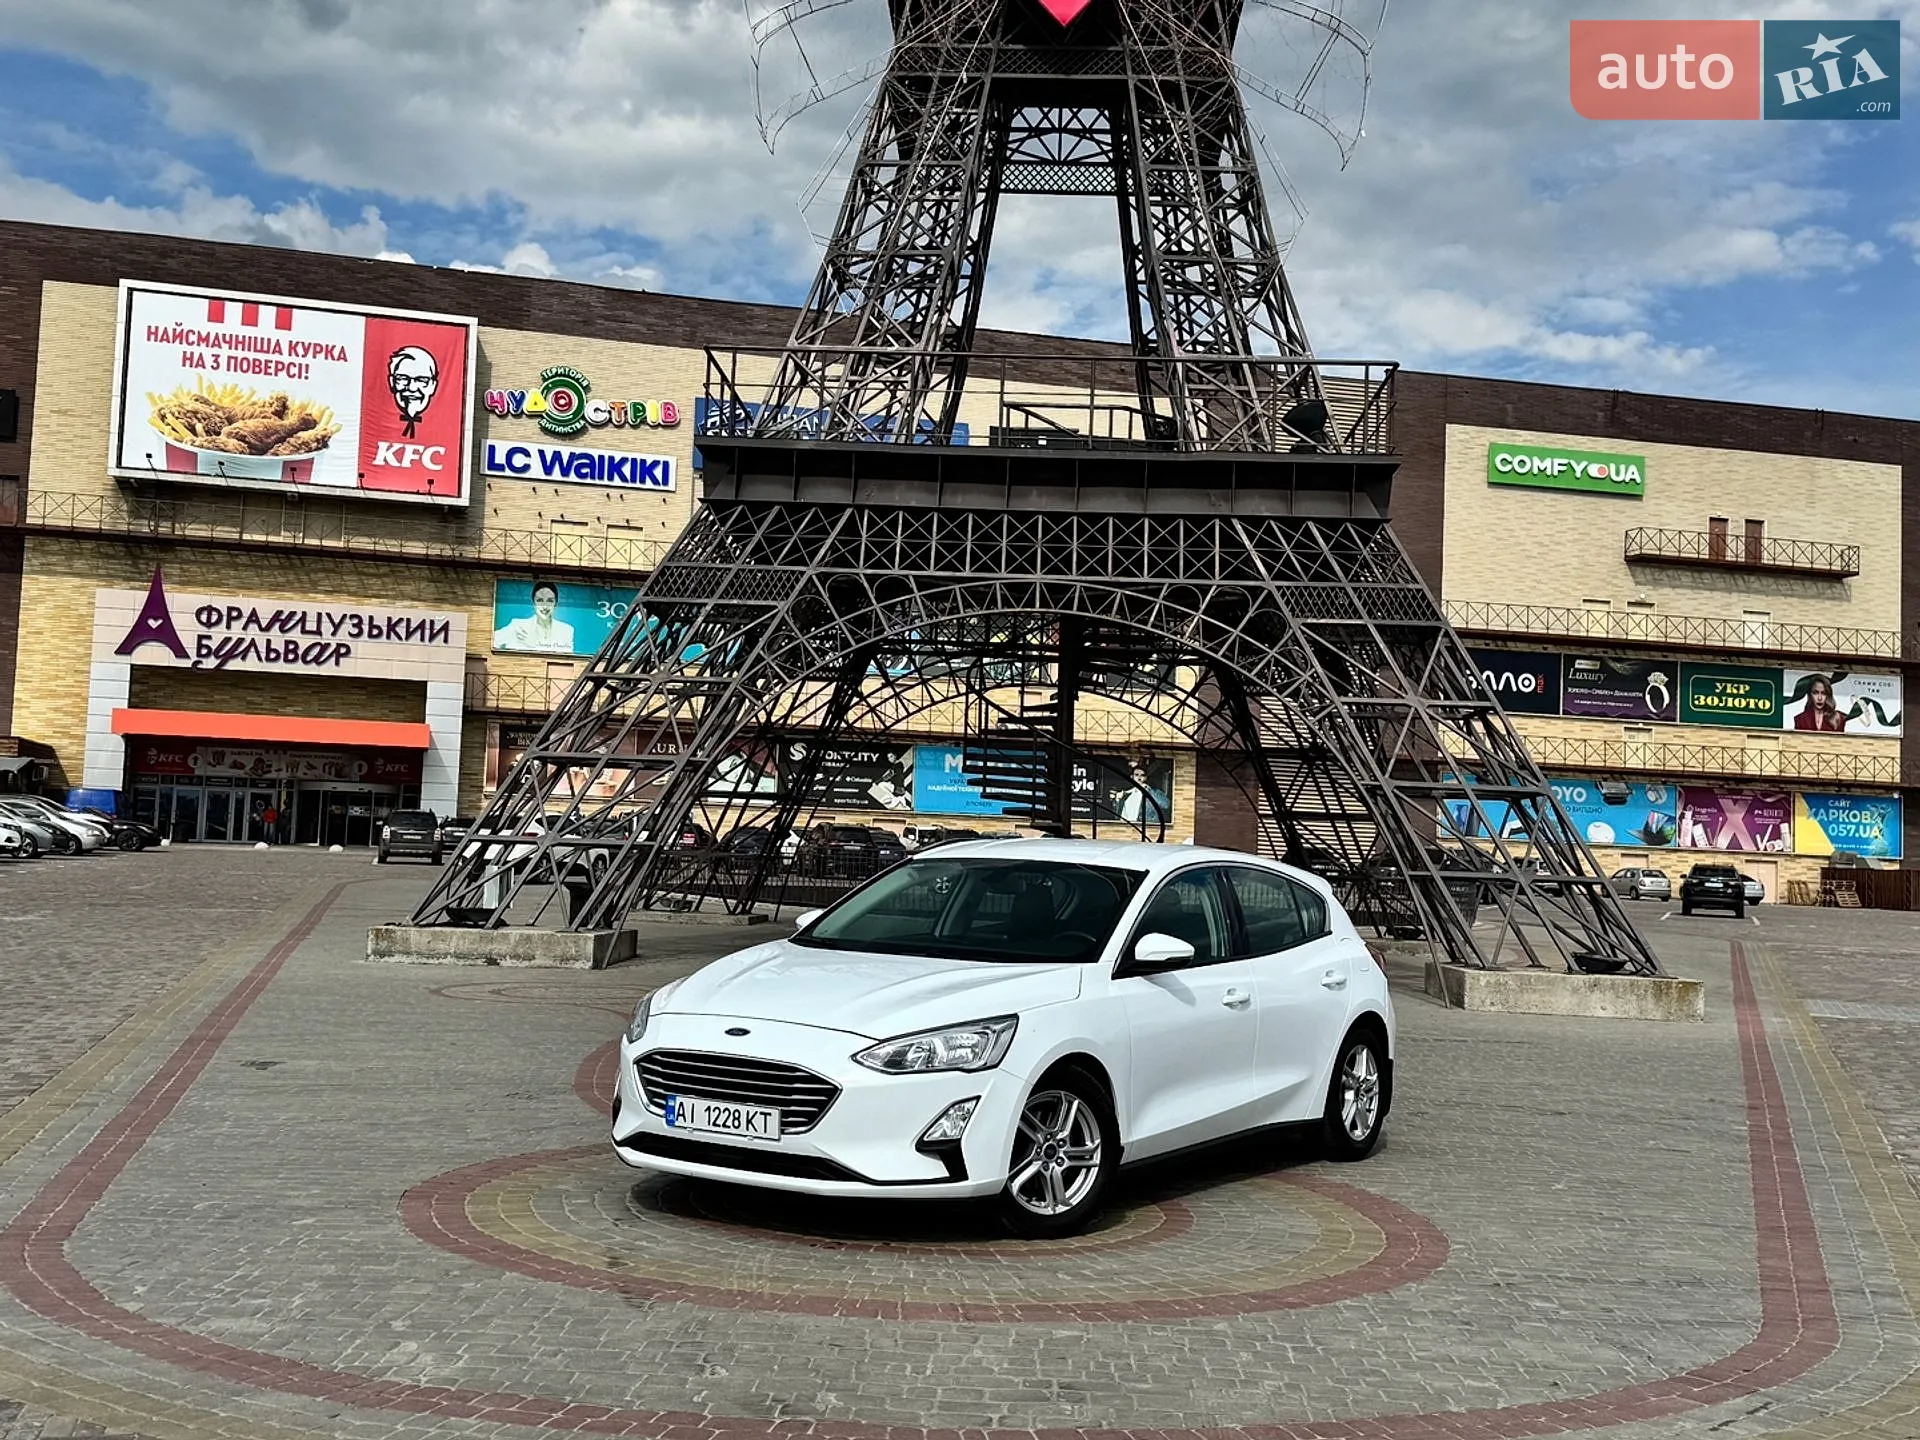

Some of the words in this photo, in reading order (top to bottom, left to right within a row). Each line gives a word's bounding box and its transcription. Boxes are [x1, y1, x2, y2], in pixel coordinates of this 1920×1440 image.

[146, 322, 283, 357] НАЙСМАЧНІША
[287, 340, 348, 362] КУРКА
[181, 351, 206, 369] НА
[210, 354, 220, 371] 3
[226, 356, 310, 380] ПОВЕРСІ!
[373, 441, 446, 471] KFC
[487, 444, 531, 474] LC
[1568, 667, 1607, 684] Luxury
[1715, 682, 1751, 695] УКР
[1693, 694, 1771, 710] ЗОЛОТО
[159, 753, 184, 763] KFC
[384, 764, 409, 773] KFC
[1073, 763, 1087, 777] in
[1070, 778, 1095, 792] yle
[1828, 799, 1850, 808] САЙТ
[1828, 823, 1882, 839] 057.UA
[676, 1101, 695, 1124] AI
[704, 1105, 741, 1129] 1228
[746, 1110, 772, 1134] KT
